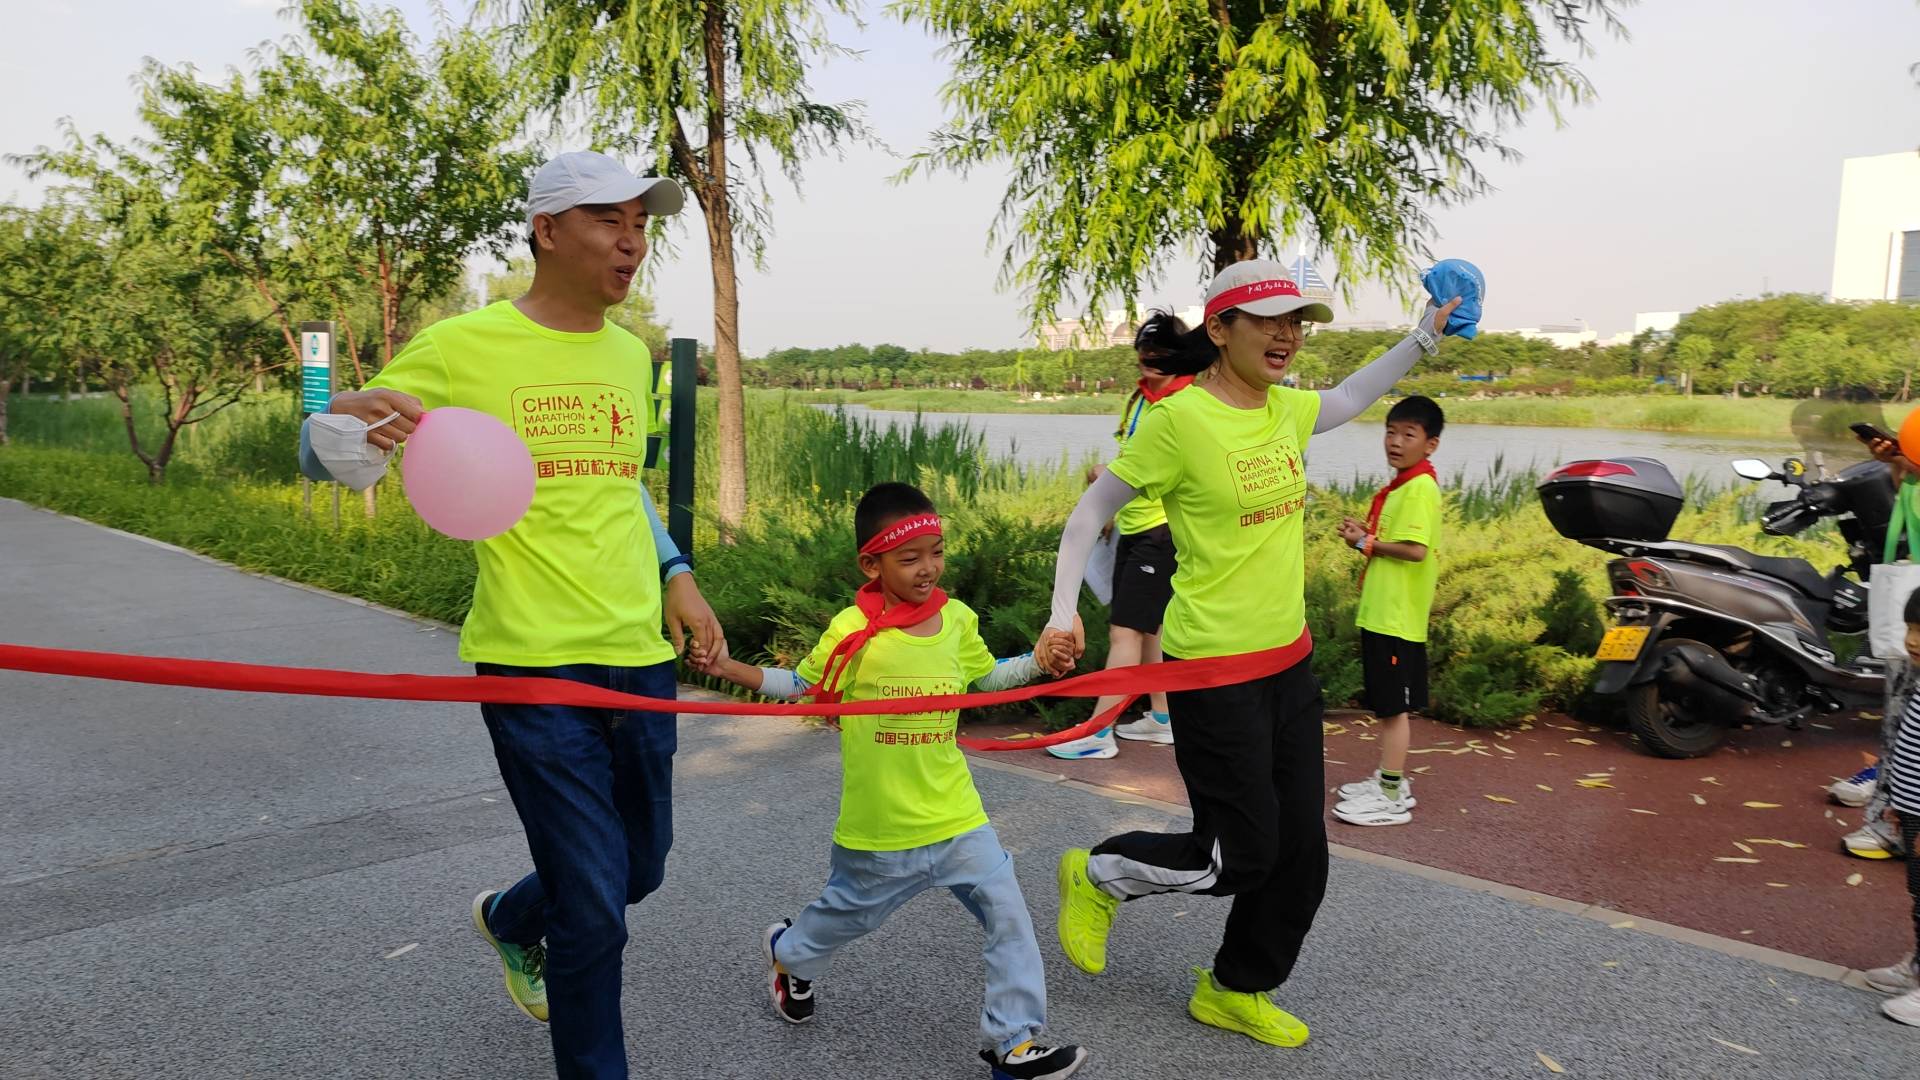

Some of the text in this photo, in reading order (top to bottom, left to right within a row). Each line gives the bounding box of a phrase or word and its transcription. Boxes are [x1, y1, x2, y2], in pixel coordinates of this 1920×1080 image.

[522, 395, 584, 413] CHINA
[524, 412, 585, 424] MARATHON
[525, 423, 586, 438] MAJORS
[534, 459, 638, 480] 国马拉松大满贯
[1236, 454, 1273, 473] CHINA
[1240, 465, 1277, 482] MARATHON
[1243, 475, 1280, 493] MAJORS
[882, 685, 924, 697] CHINA
